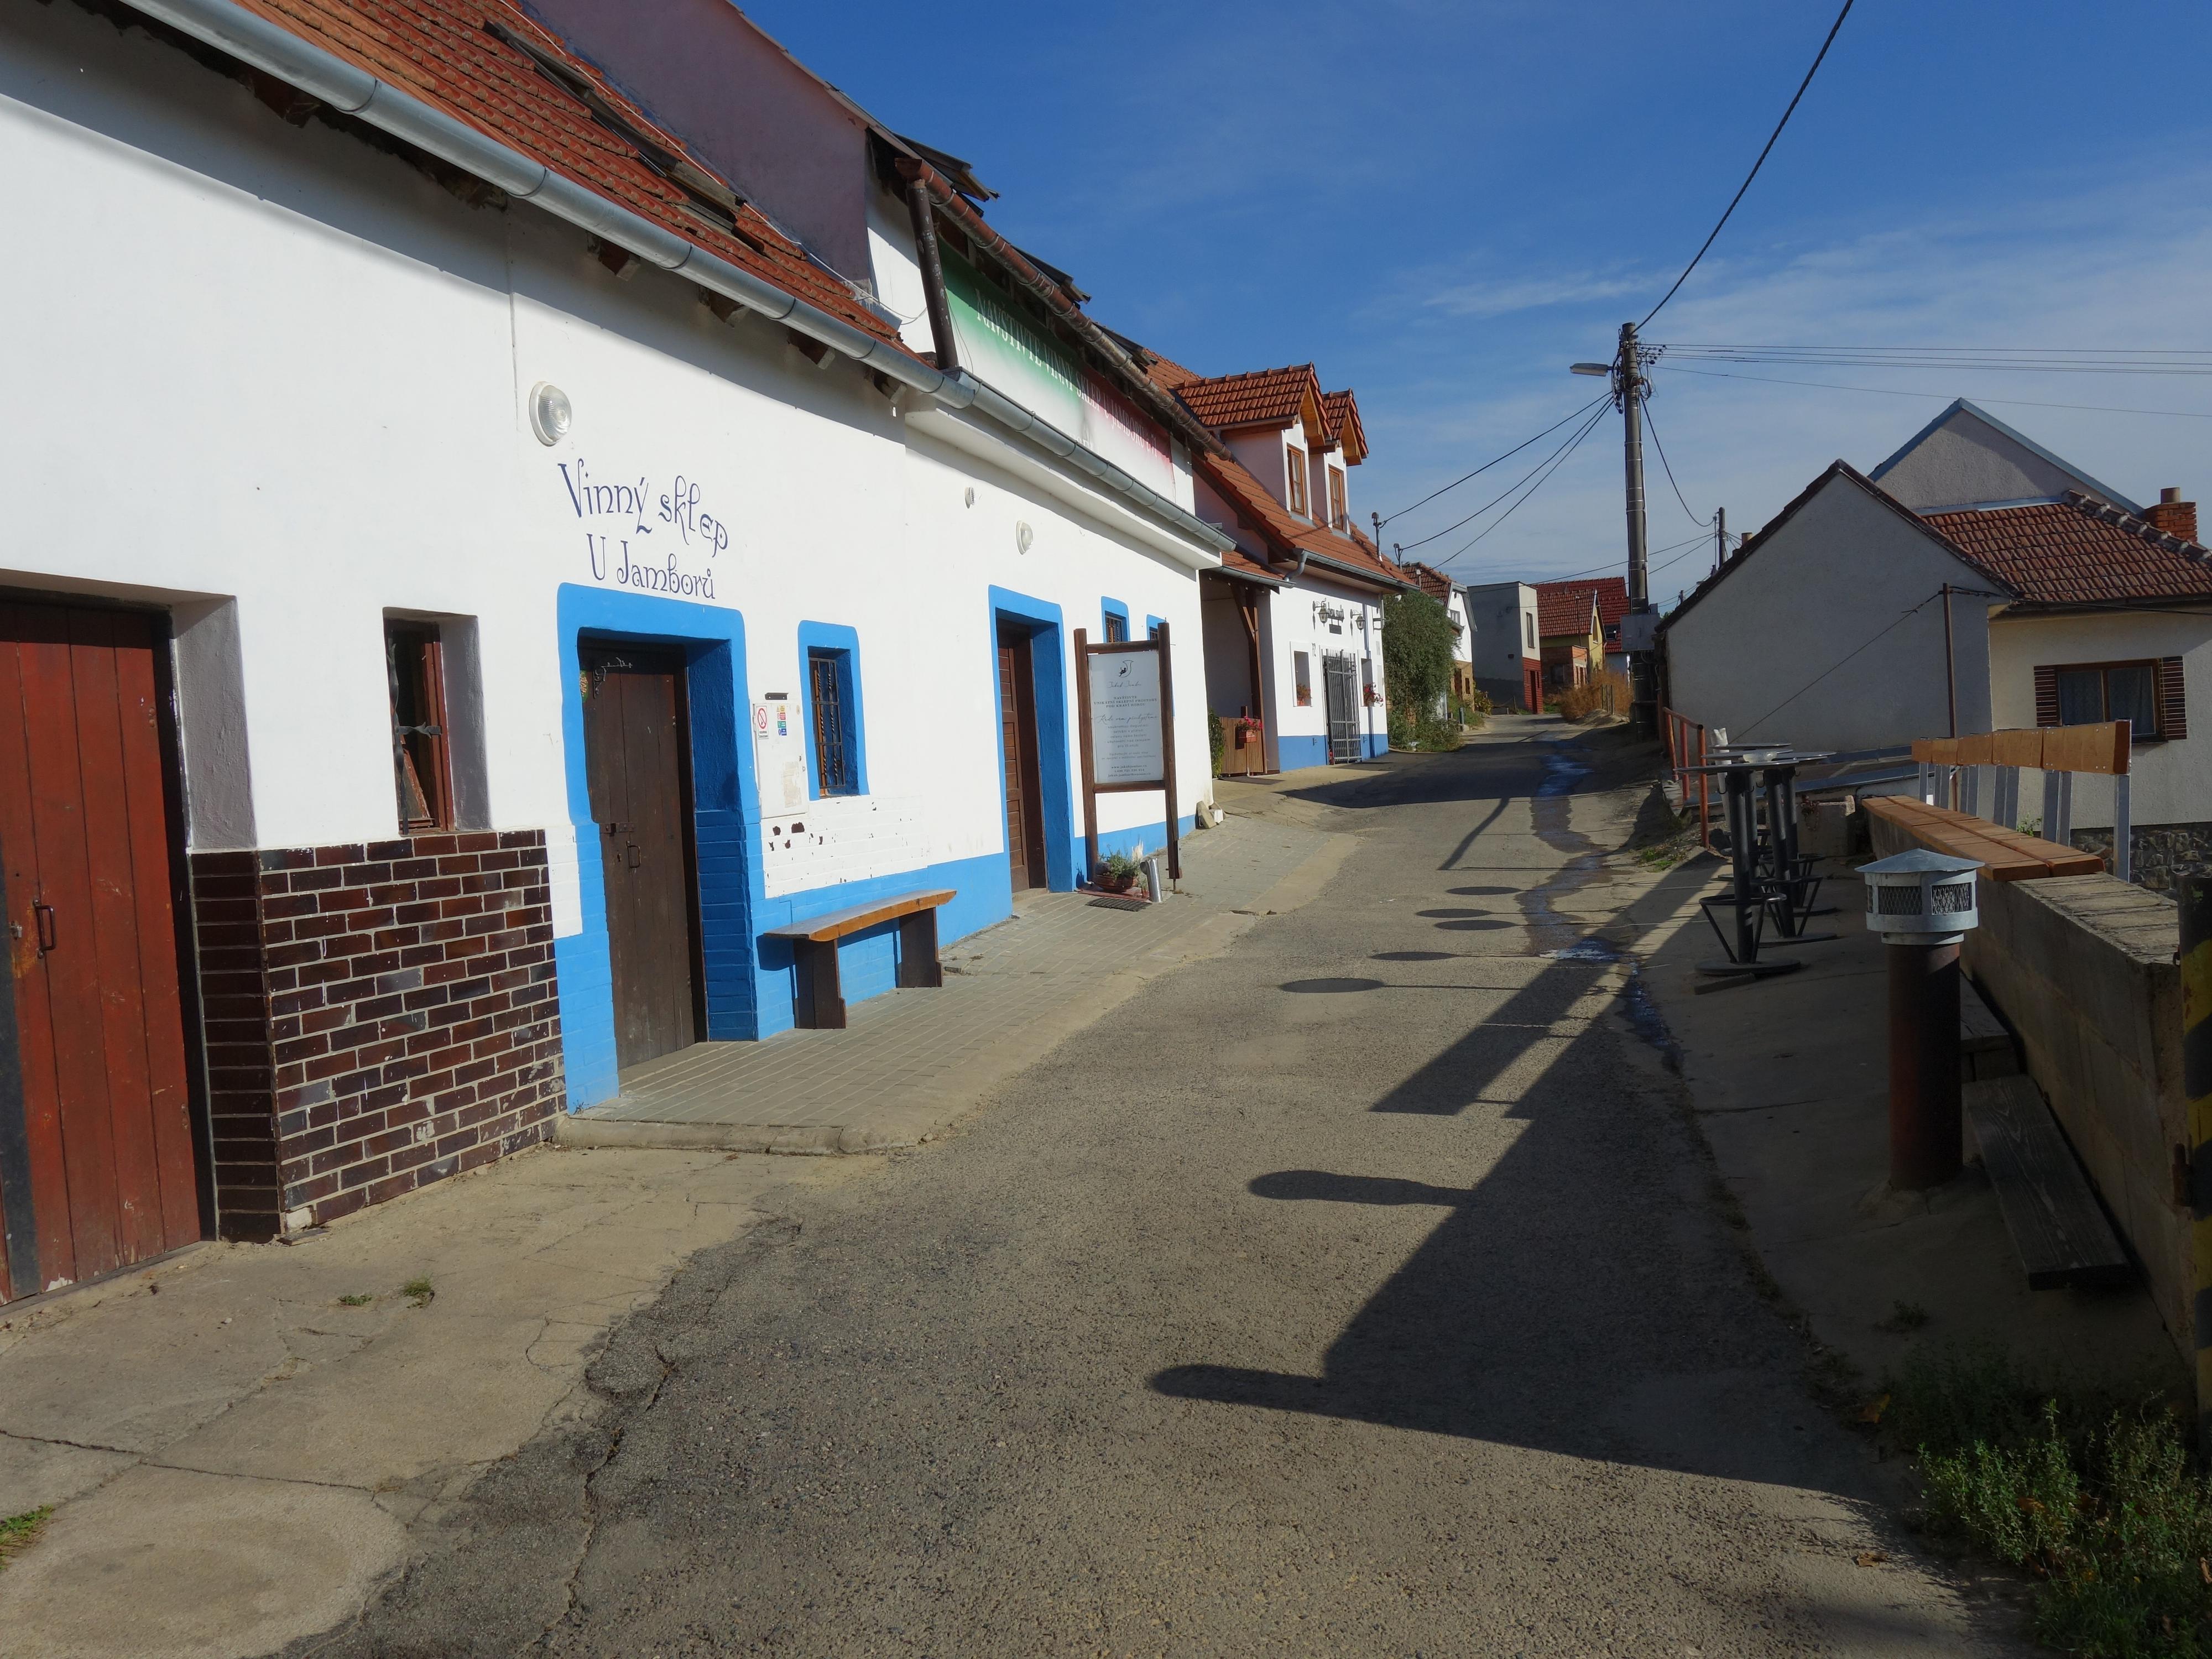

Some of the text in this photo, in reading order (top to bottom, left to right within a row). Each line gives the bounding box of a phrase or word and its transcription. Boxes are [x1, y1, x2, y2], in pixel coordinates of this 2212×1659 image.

[557, 458, 728, 558] Vinný sklep
[587, 533, 716, 599] U Jamborů
